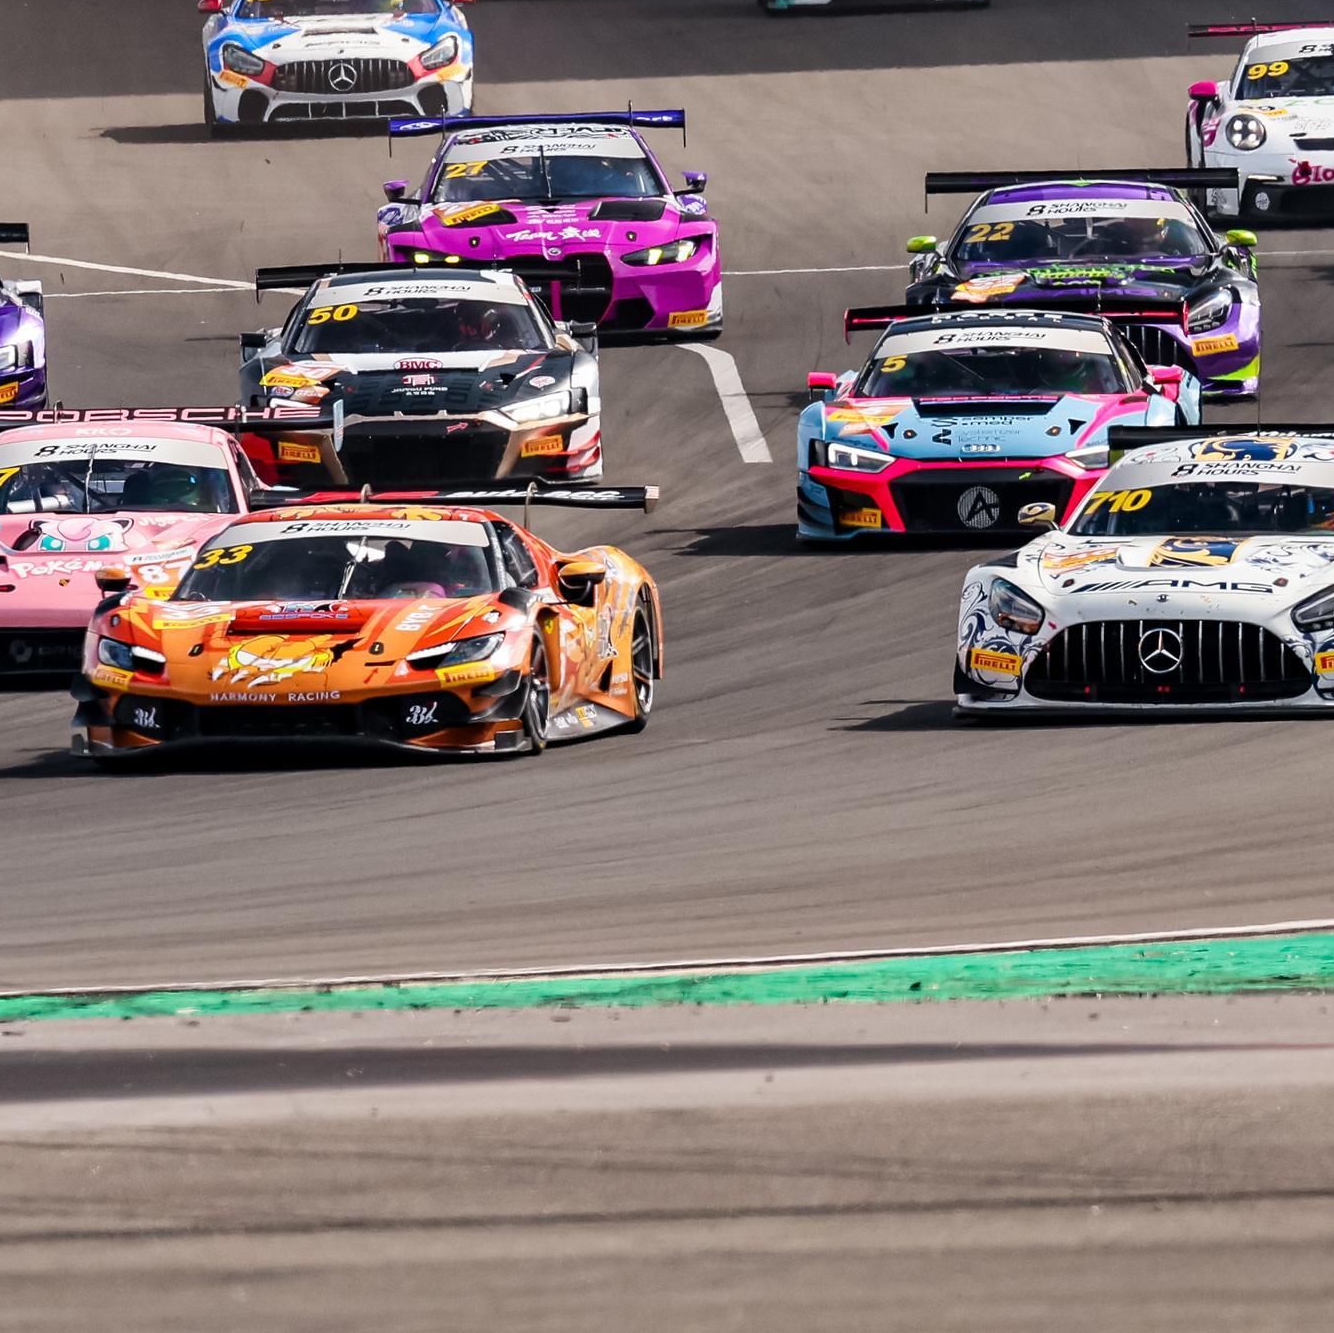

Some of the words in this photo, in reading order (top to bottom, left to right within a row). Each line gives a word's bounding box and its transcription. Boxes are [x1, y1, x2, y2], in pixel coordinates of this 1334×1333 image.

[1247, 61, 1289, 80] 99
[445, 161, 488, 179] 27
[966, 222, 1015, 243] 22
[307, 304, 358, 325] 50
[880, 355, 908, 373] 5
[34, 445, 61, 458] 8
[1171, 463, 1196, 478] 8
[1204, 462, 1303, 472] SHANGHAI
[1197, 468, 1260, 477] HOURS
[1084, 489, 1153, 515] 710
[280, 523, 308, 535] 8
[194, 545, 254, 569] 33
[1132, 579, 1274, 594] AMG
[974, 651, 1018, 671] PIRELLI
[210, 691, 276, 702] HARMONY
[288, 690, 341, 702] RACING
